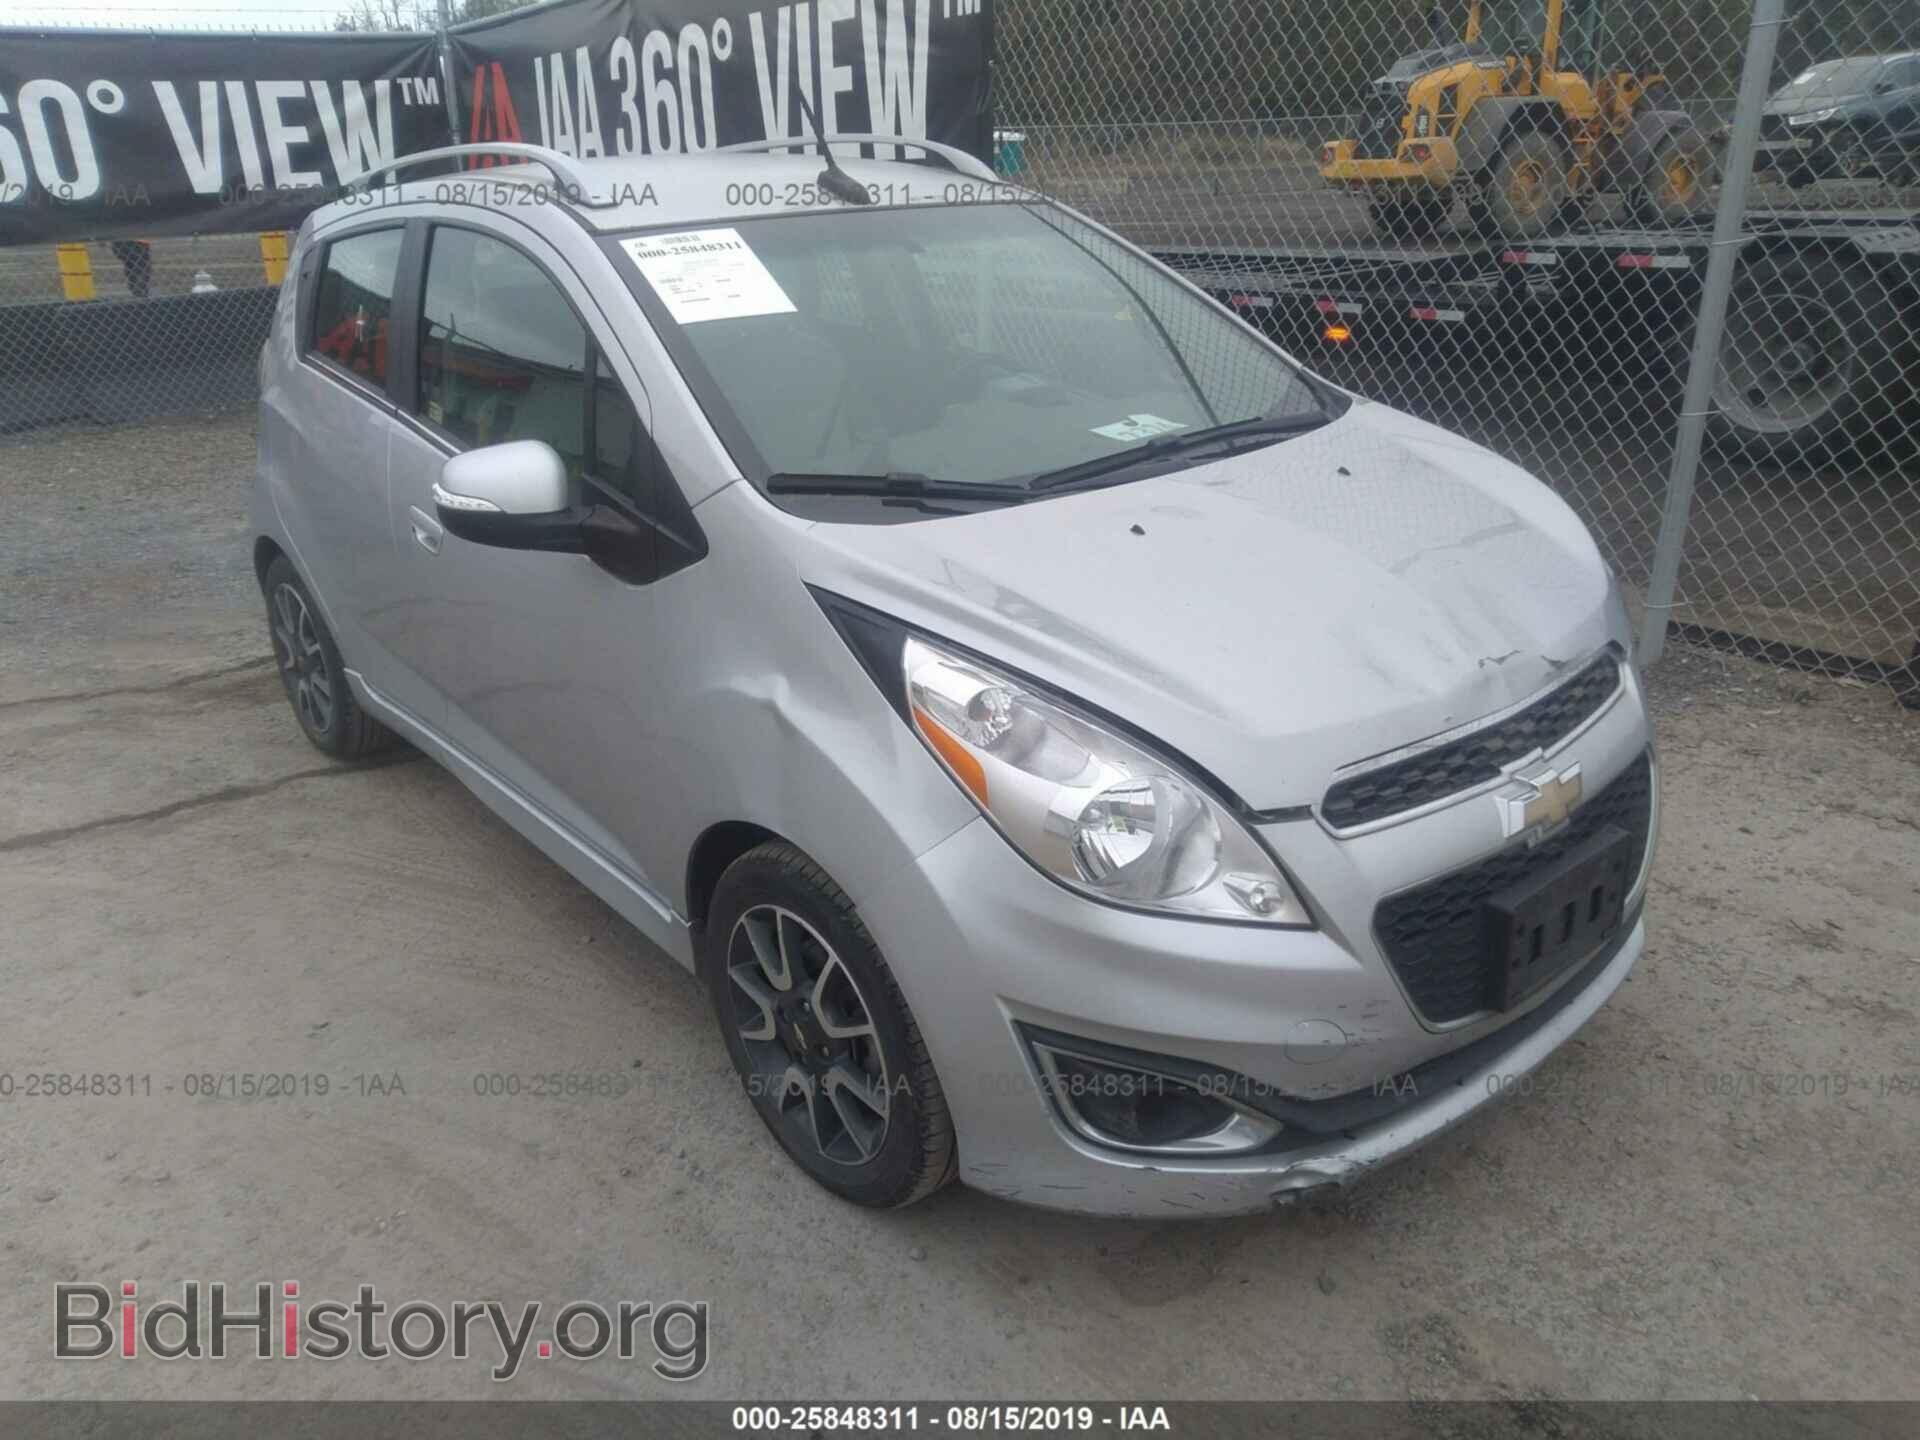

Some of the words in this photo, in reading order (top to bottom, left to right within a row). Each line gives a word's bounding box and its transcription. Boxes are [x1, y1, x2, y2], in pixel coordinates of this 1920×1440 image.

[534, 46, 604, 160] IAA
[611, 17, 732, 157] 360°
[637, 240, 742, 260] 000-25848311
